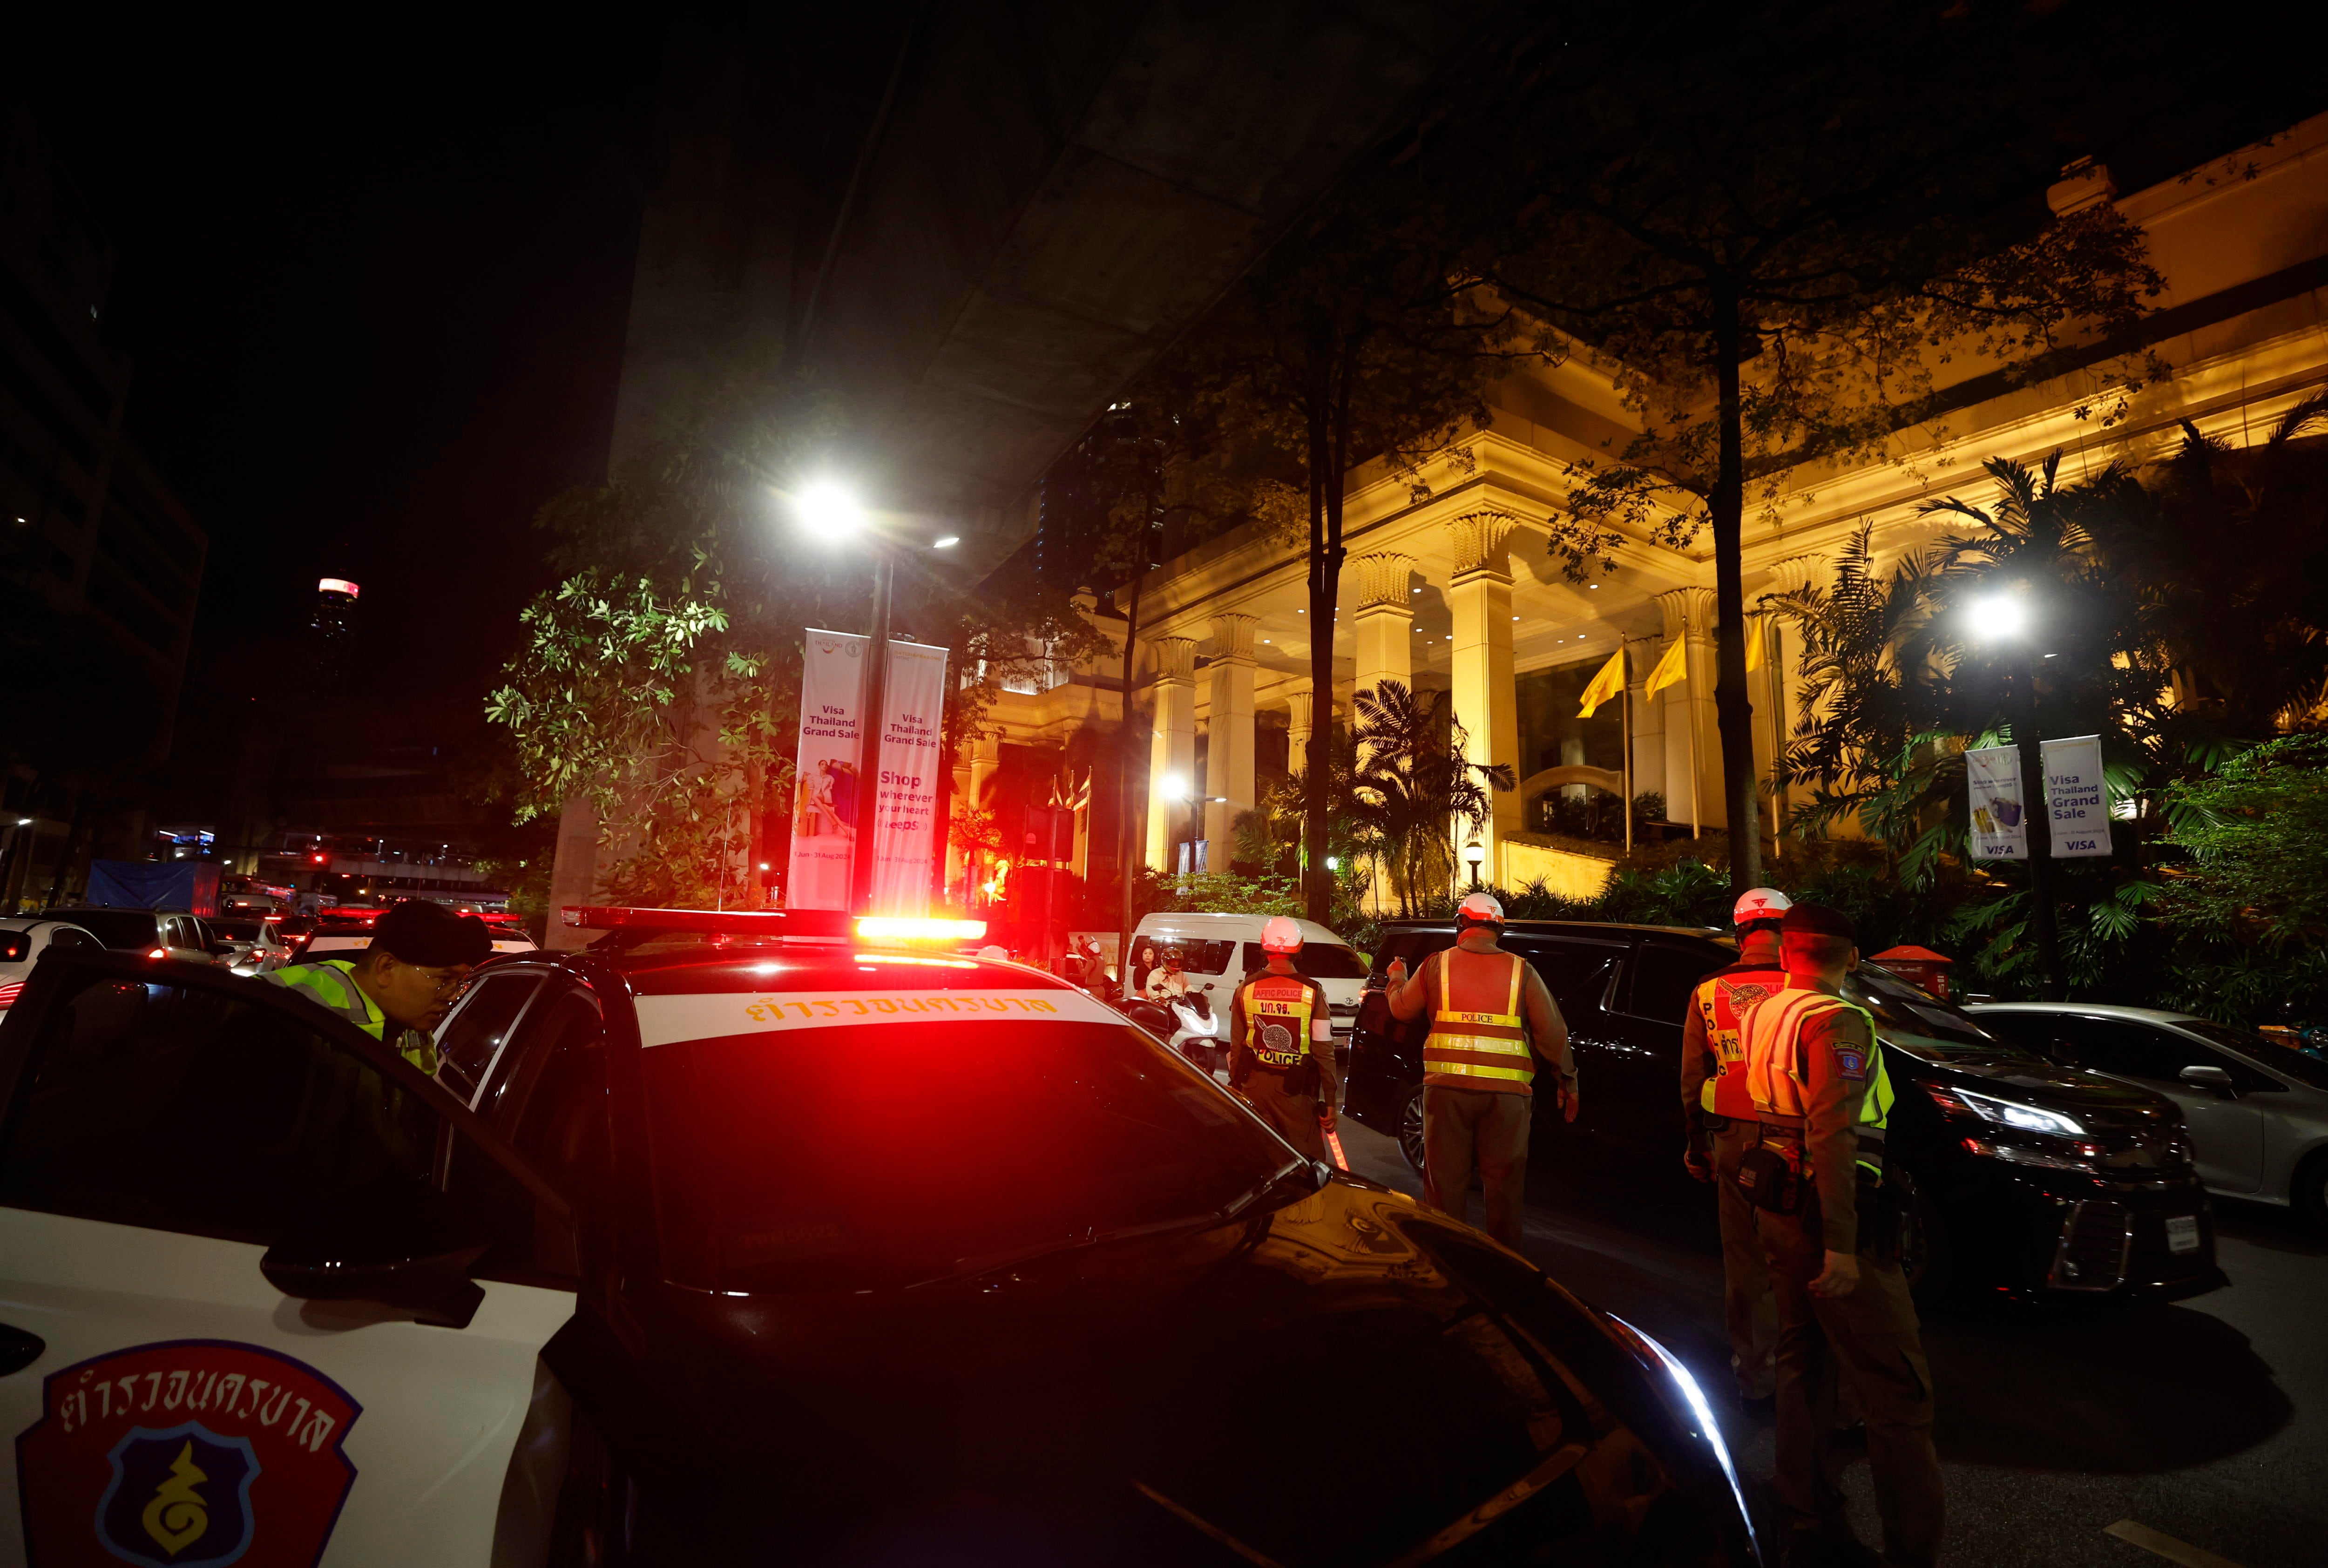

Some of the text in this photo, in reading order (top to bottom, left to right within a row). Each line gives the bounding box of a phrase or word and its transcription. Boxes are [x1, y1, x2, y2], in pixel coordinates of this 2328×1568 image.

[822, 705, 845, 715] Visa
[809, 716, 855, 727] Thailand
[902, 714, 922, 724] Visa
[803, 727, 859, 739] Grand Sale
[890, 724, 932, 736] Thailand
[884, 735, 936, 748] Grand Sale
[880, 771, 921, 789] Shop
[2050, 775, 2079, 785] Visa
[2051, 784, 2098, 795] Thailand
[880, 790, 933, 803] wherever
[2052, 794, 2099, 807] Grand
[903, 805, 929, 815] heart
[2054, 808, 2086, 819] Sale
[1985, 845, 2014, 854] VISA
[2064, 840, 2097, 850] VISA
[745, 998, 1058, 1021] ตำรวจนครบาล
[1260, 1002, 1290, 1014] บก.จร.
[1461, 1014, 1493, 1023] POLICE
[1703, 1003, 1726, 1075] POLIC
[1257, 1048, 1301, 1065] POLICE
[61, 1370, 336, 1453] ตำรวจนครบาล
